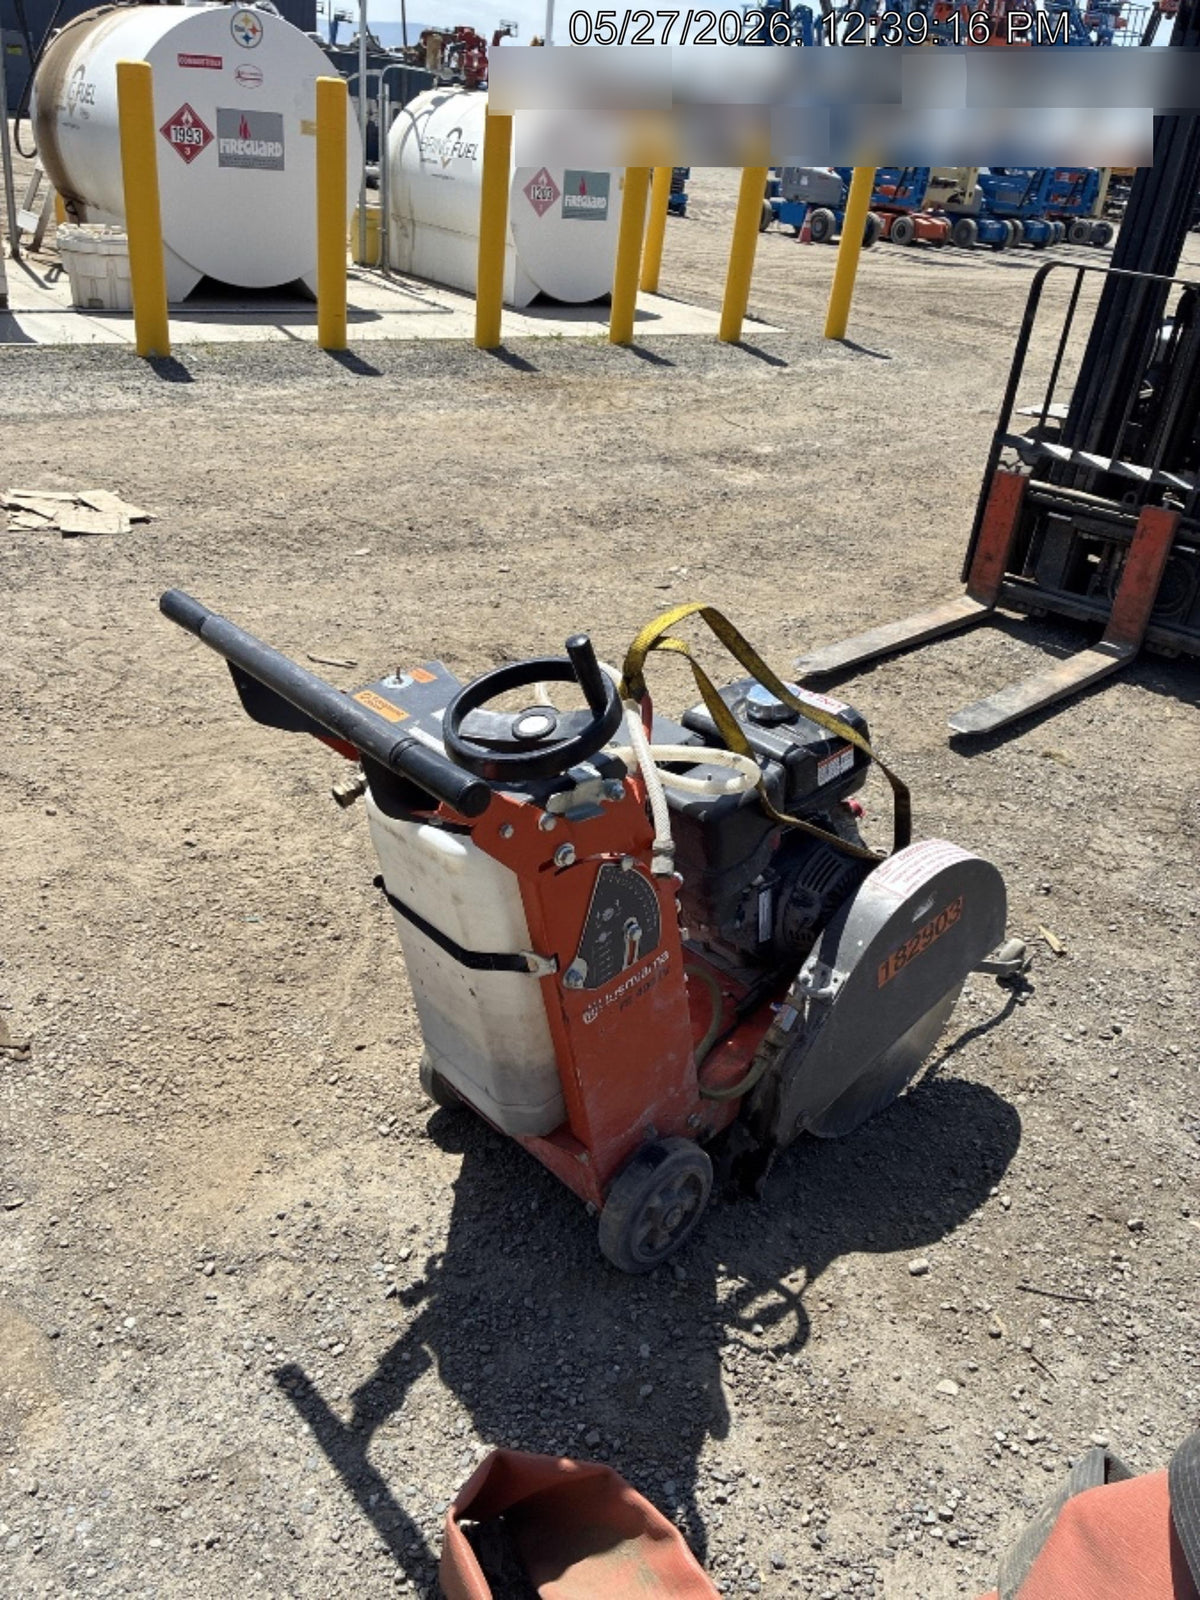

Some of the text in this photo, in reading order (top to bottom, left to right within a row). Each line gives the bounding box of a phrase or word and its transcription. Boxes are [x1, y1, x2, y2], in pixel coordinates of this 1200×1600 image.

[172, 127, 202, 145] 1993
[184, 146, 191, 156] 3
[451, 141, 479, 161] FUEL
[880, 898, 963, 984] 182903
